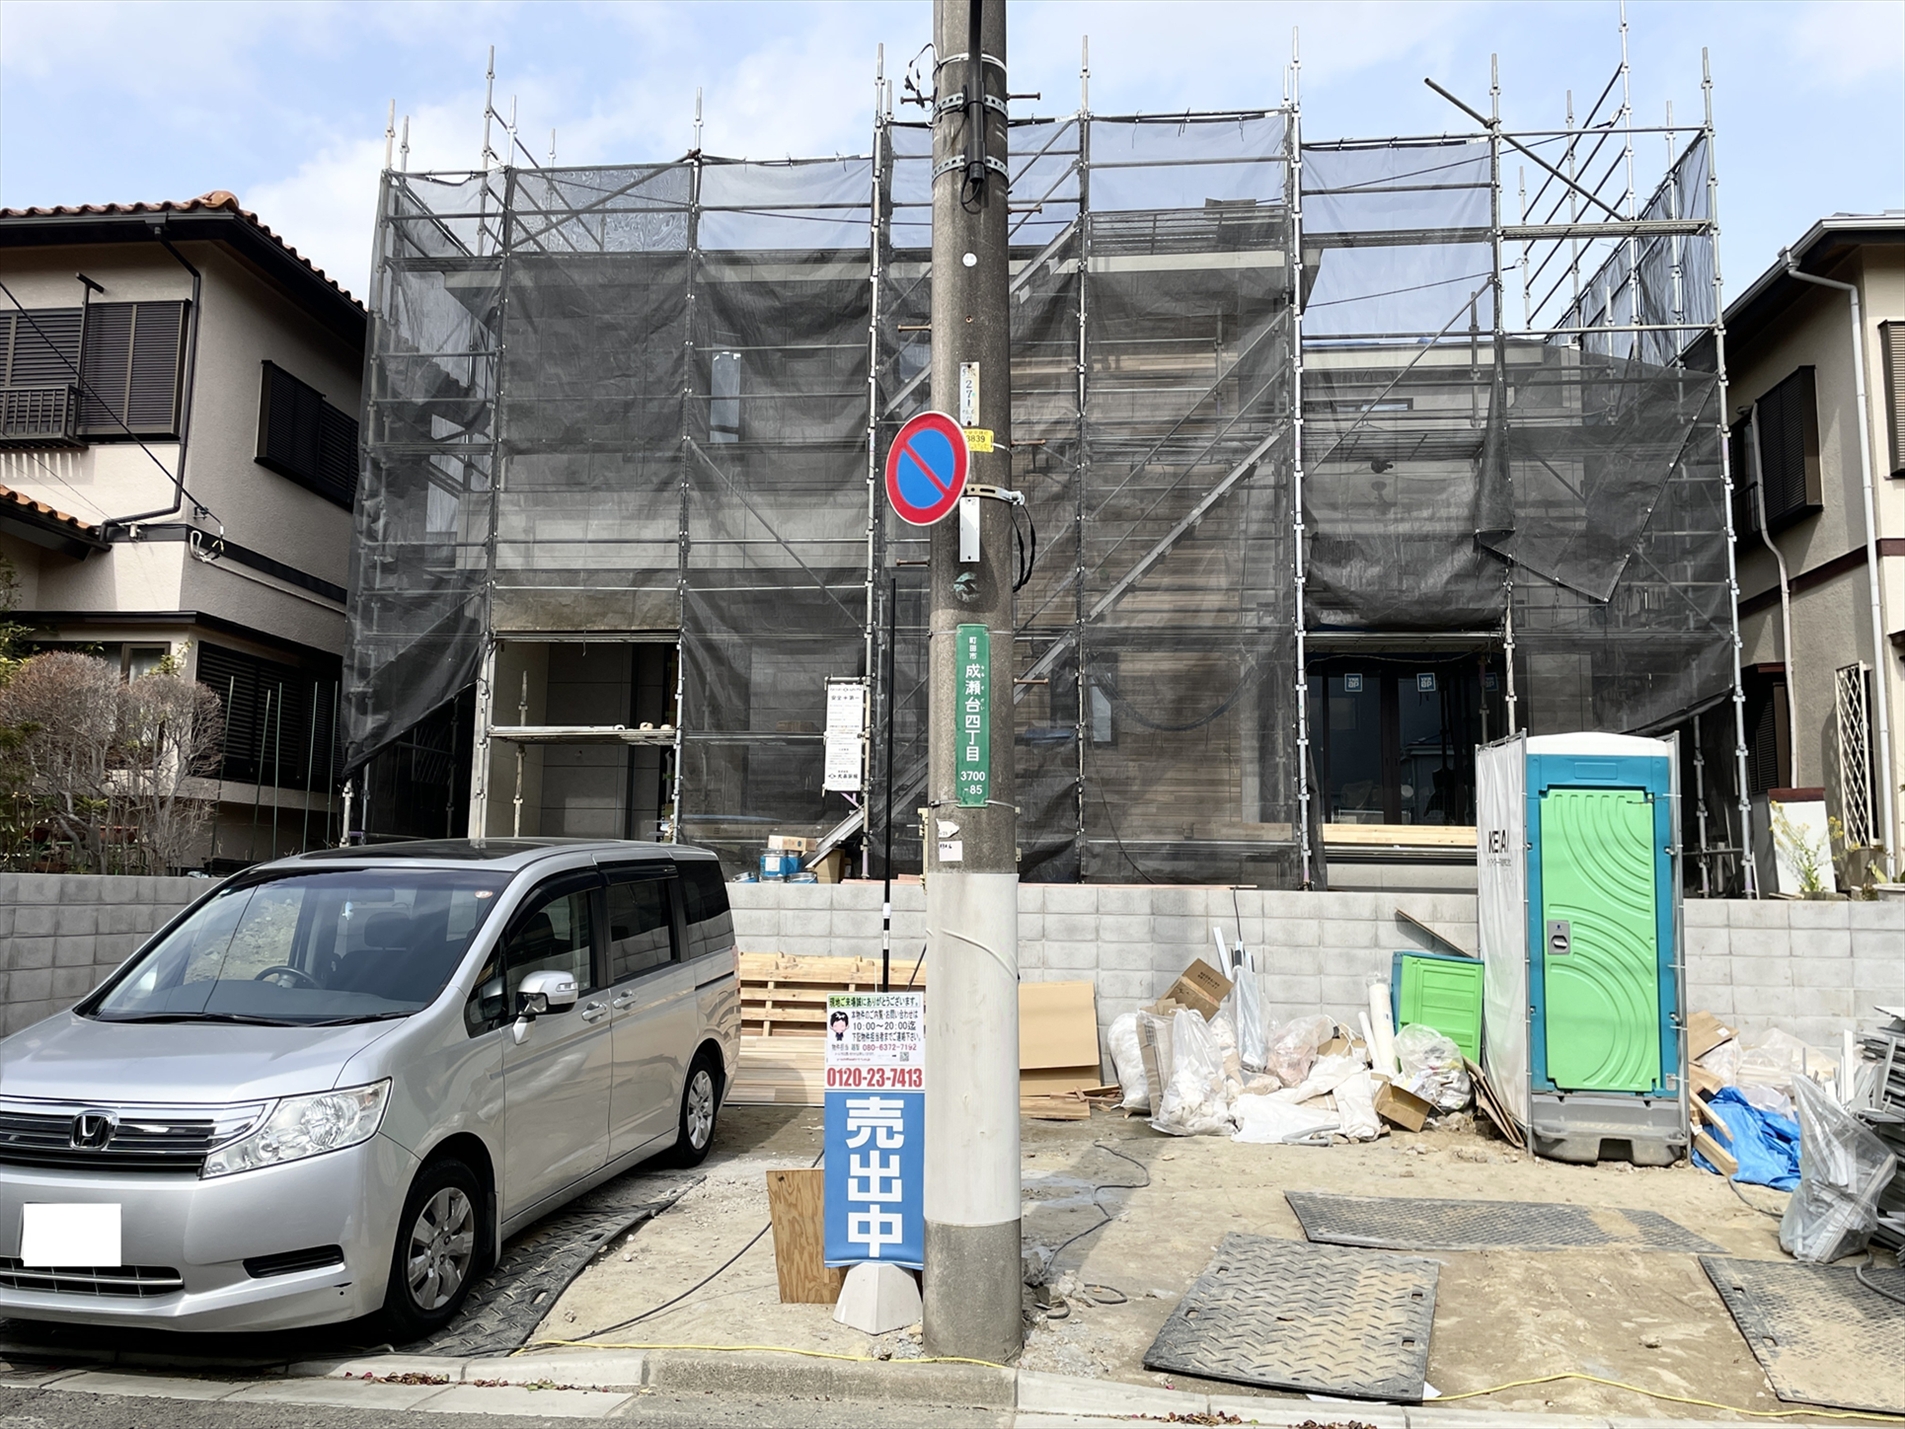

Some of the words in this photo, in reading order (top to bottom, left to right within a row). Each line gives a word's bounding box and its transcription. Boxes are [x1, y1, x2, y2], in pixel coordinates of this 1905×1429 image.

[968, 636, 978, 660] 町田市
[965, 663, 981, 762] 成瀬台四丁目
[960, 771, 986, 781] 3700
[964, 785, 983, 794] -85
[827, 1067, 923, 1088] 0120-23-7413
[846, 1096, 904, 1258] 売出中
